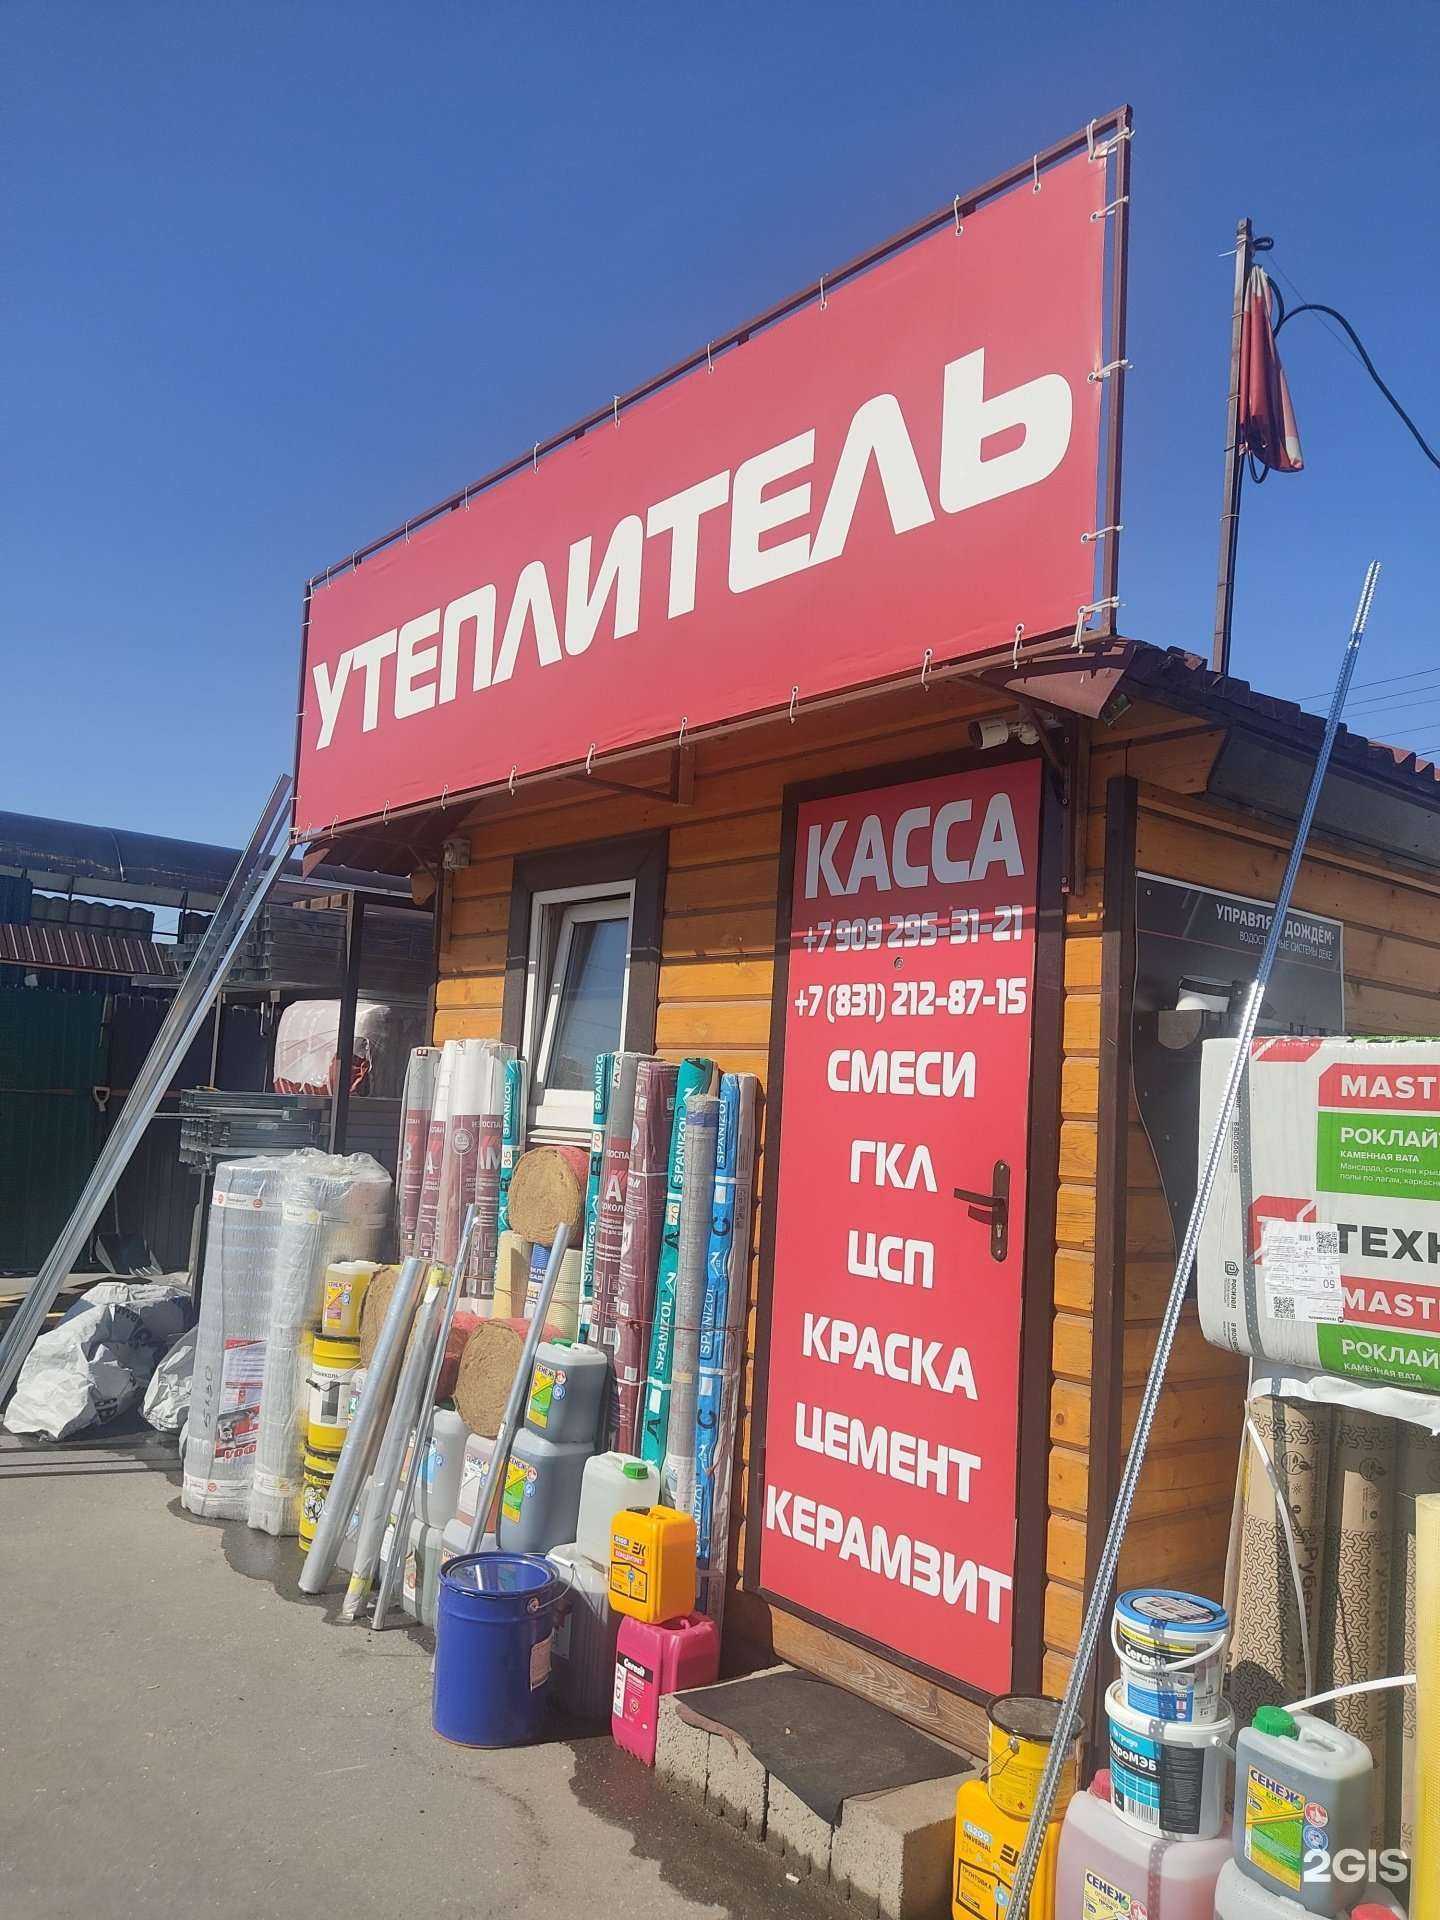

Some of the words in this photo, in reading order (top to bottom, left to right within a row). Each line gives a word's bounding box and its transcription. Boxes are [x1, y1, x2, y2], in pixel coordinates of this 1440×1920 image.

[313, 347, 1073, 750] УТЕПЛИТЕЛЬ
[804, 793, 1025, 898] КАССА
[803, 925, 832, 953] +7
[836, 916, 882, 951] 909
[887, 904, 1023, 949] 295-31-21
[1216, 904, 1273, 930] УПРАВЛЯ
[794, 990, 824, 1018] +7
[826, 983, 885, 1023] (831)
[891, 976, 1028, 1016] 212-87-15
[827, 1049, 977, 1098] СМЕСИ
[503, 1078, 512, 1138] SPANIZOL
[717, 1100, 727, 1167] SPANIZOL
[1340, 1151, 1393, 1160] КАМЕННАЯ
[1395, 1154, 1419, 1162] ВАТА
[1341, 1127, 1440, 1148] РОКЛАЙ
[850, 1139, 938, 1193] ГКЛ
[848, 1230, 934, 1289] ЦСП
[701, 1286, 713, 1354] SPANIZOL
[802, 1312, 978, 1400] КРАСКА
[1344, 1363, 1396, 1378] КАМЕННАЯ
[1398, 1371, 1422, 1382] ВАТА
[795, 1402, 981, 1503] ЦЕМЕНТ
[765, 1484, 1012, 1624] КЕРАМЗИТ
[1125, 1644, 1167, 1668] Ceresit
[1250, 1769, 1300, 1803] СЕНЕЖ
[1087, 1873, 1126, 1903] СЕНЕЖ
